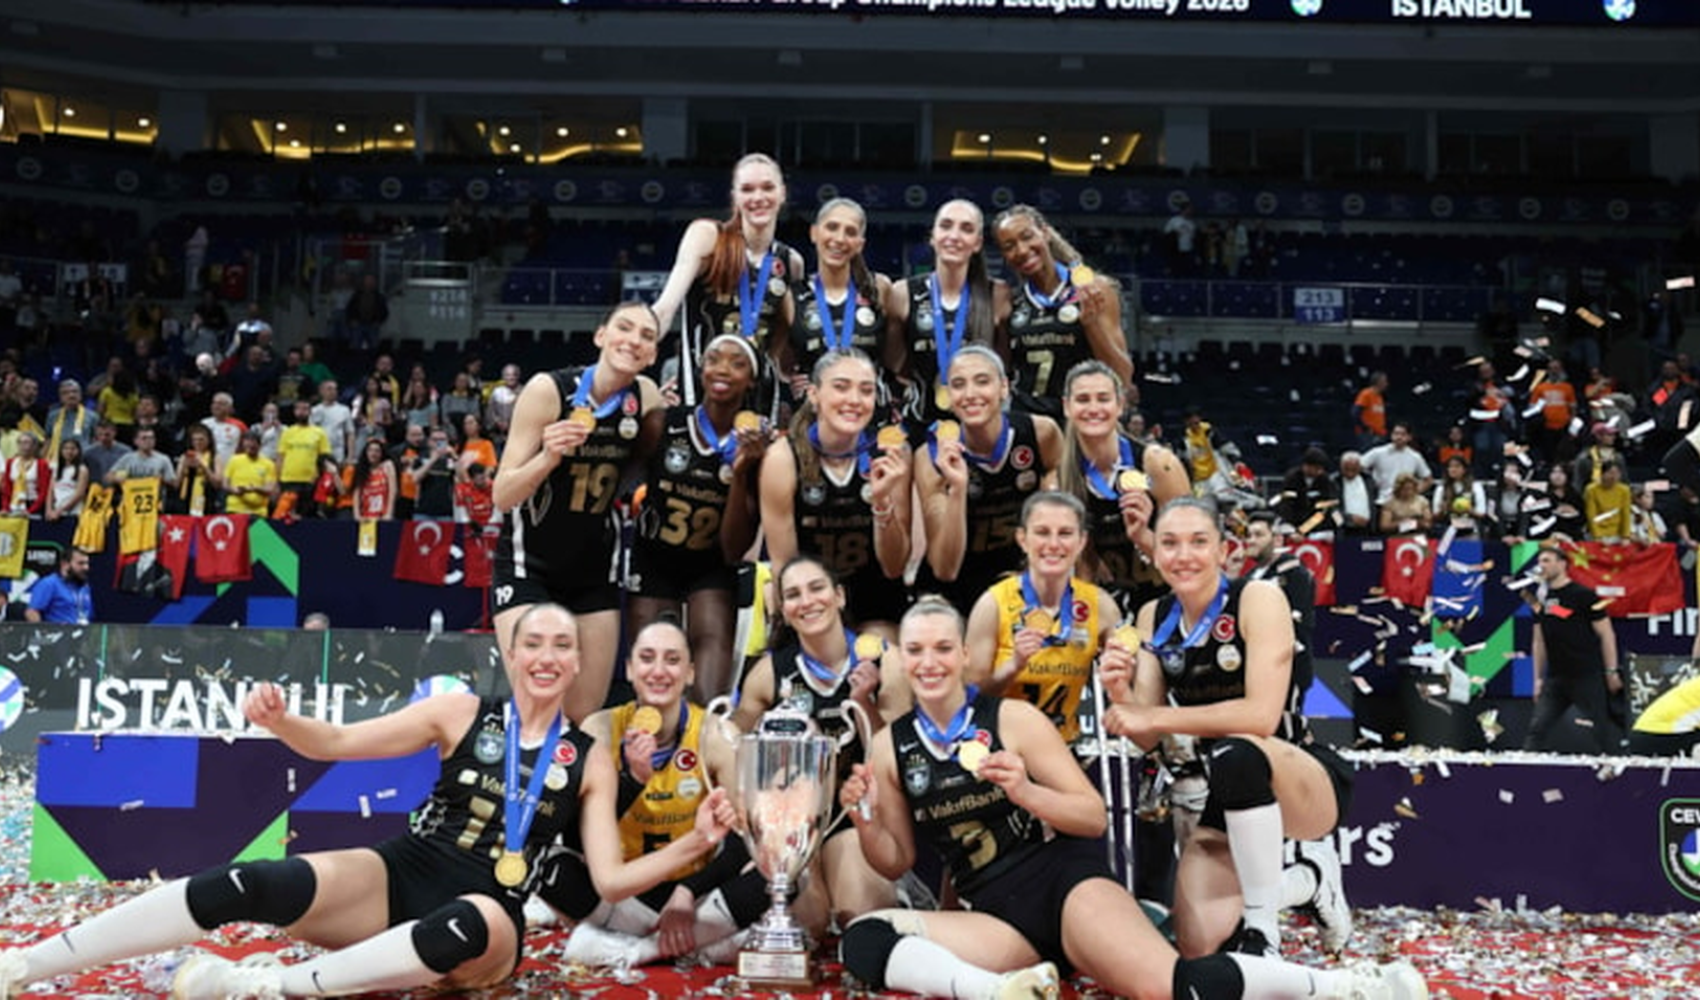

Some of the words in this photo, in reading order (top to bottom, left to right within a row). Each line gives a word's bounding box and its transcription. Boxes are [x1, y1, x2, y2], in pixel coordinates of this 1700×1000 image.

[1392, 0, 1532, 18] ISTANBUL
[1303, 291, 1335, 304] 213
[1026, 350, 1056, 398] 7
[569, 462, 619, 514] 19
[134, 493, 155, 515] 23
[659, 496, 720, 550] 32
[495, 584, 514, 606] 19
